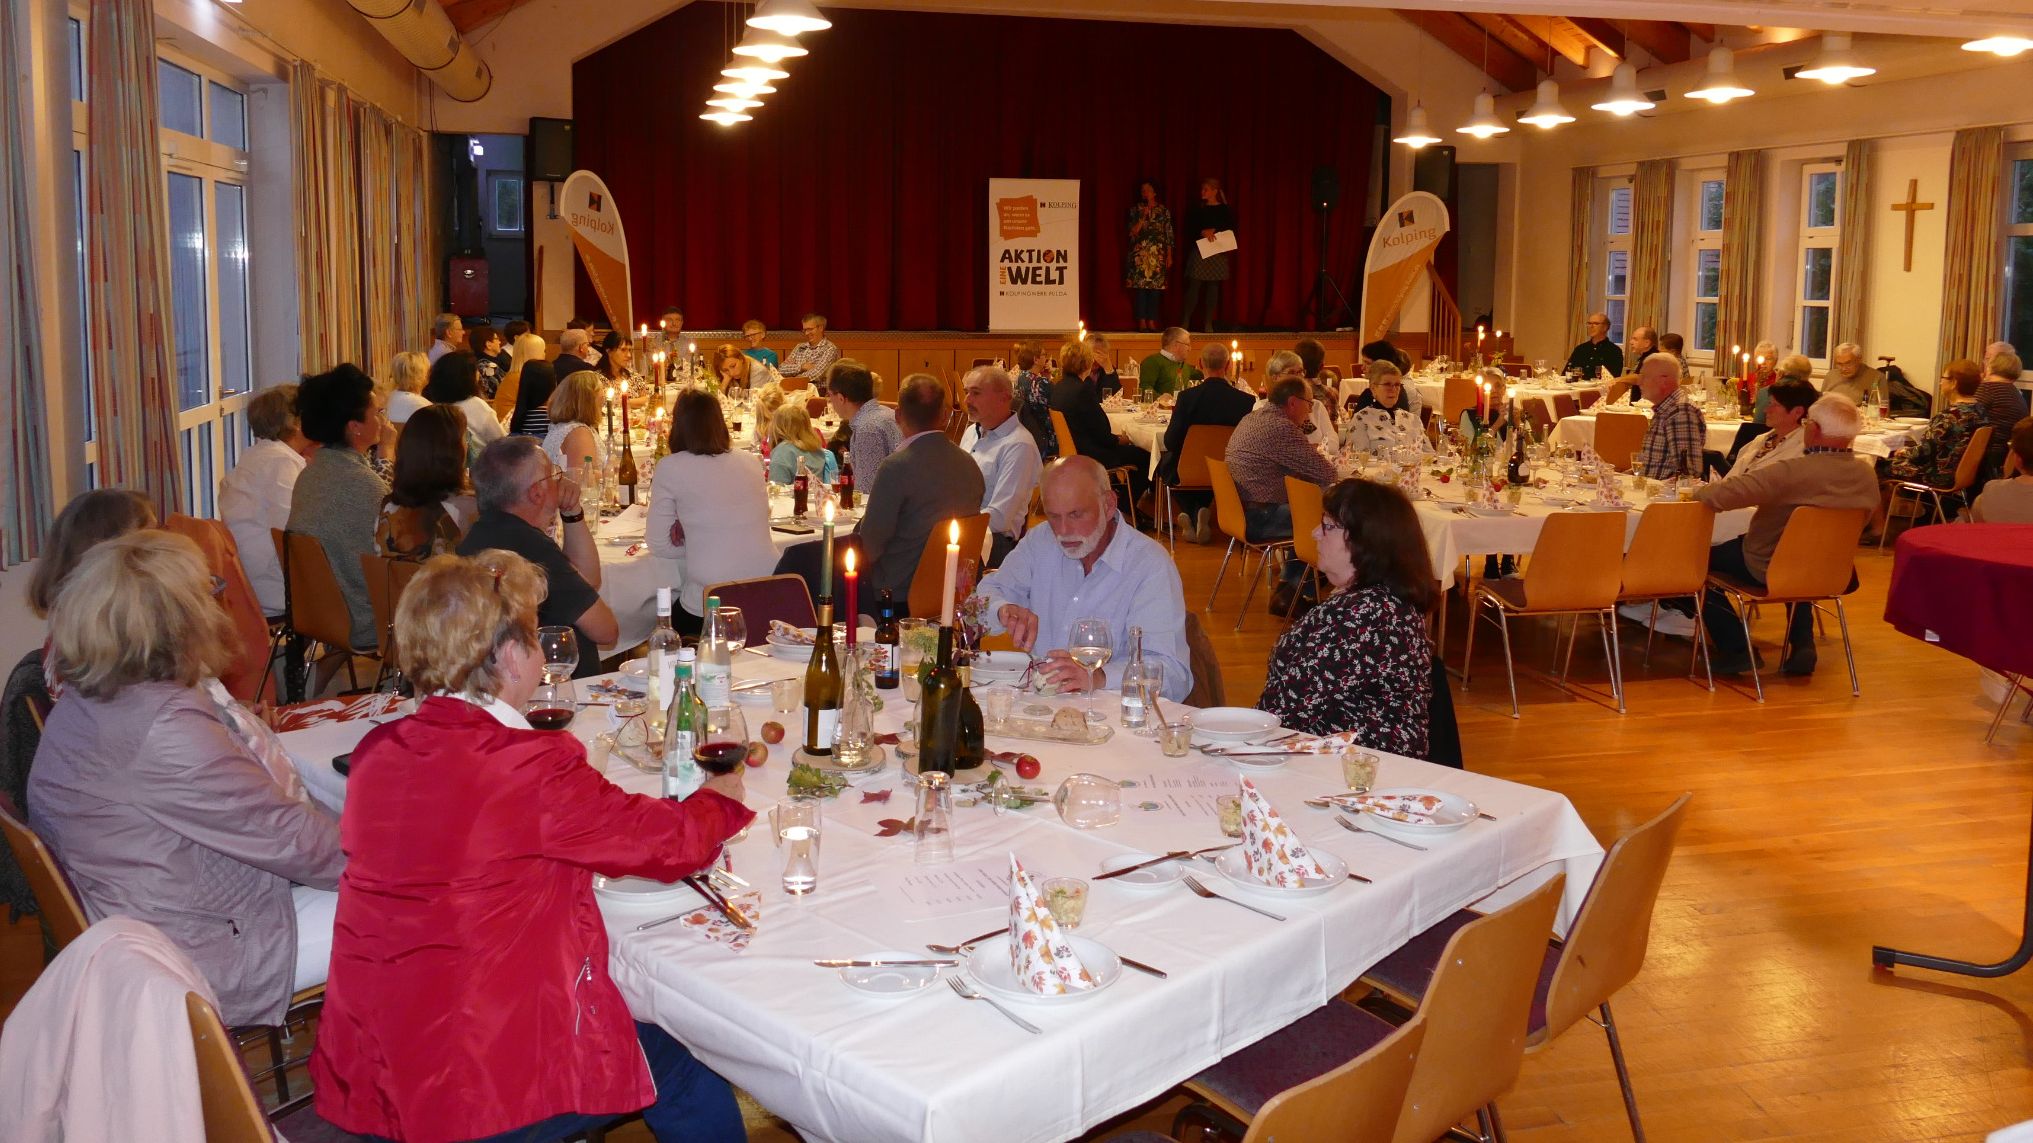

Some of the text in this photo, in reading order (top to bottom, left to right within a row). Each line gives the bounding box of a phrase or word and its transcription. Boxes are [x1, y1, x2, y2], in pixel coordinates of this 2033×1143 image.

[1048, 201, 1077, 209] KOLPING
[1382, 228, 1437, 248] Kolping
[1000, 249, 1068, 264] AKTION
[1007, 266, 1068, 285] WELT
